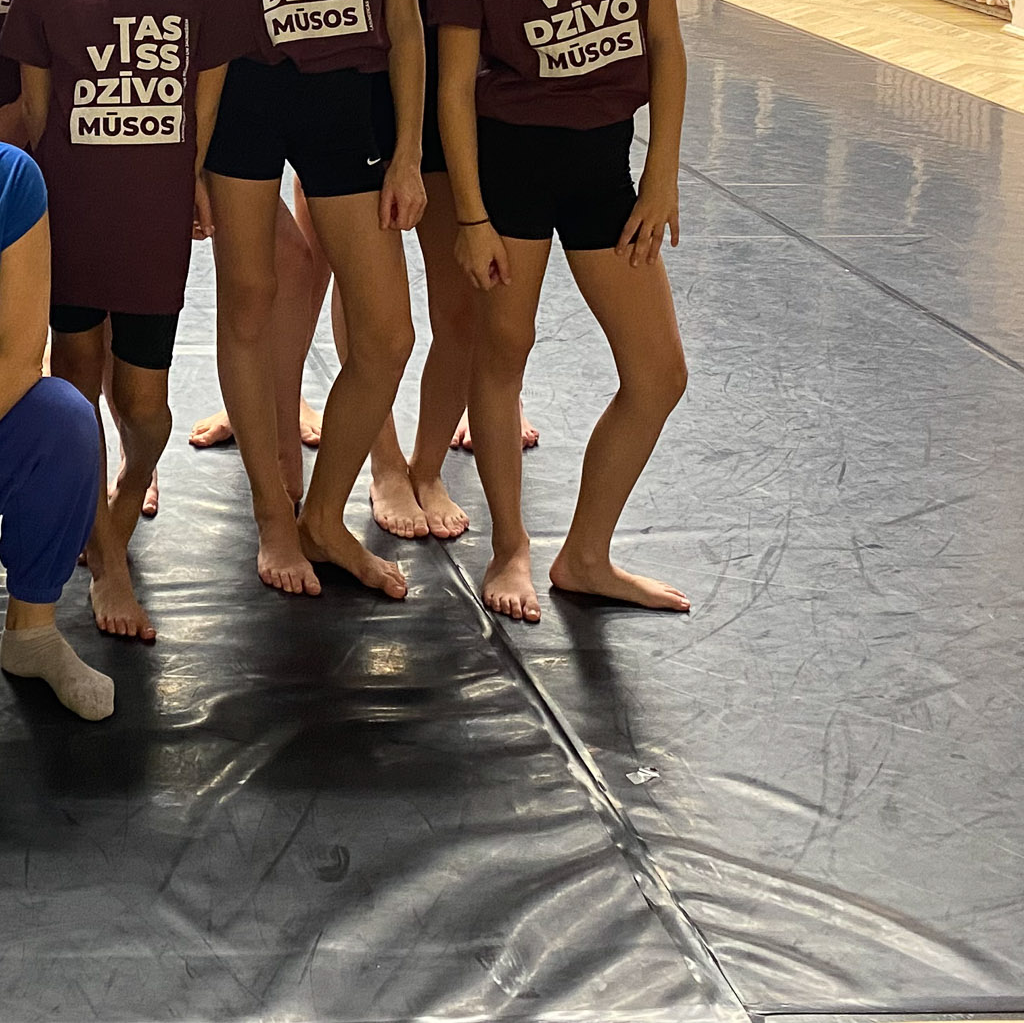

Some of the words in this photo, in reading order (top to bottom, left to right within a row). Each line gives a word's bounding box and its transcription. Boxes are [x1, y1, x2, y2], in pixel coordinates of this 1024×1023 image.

[272, 6, 358, 36] MŪSOS
[114, 16, 182, 63] TAS
[548, 31, 634, 71] MŪSOS
[74, 71, 182, 106] DZĪVO
[78, 112, 174, 136] MŪSOS
